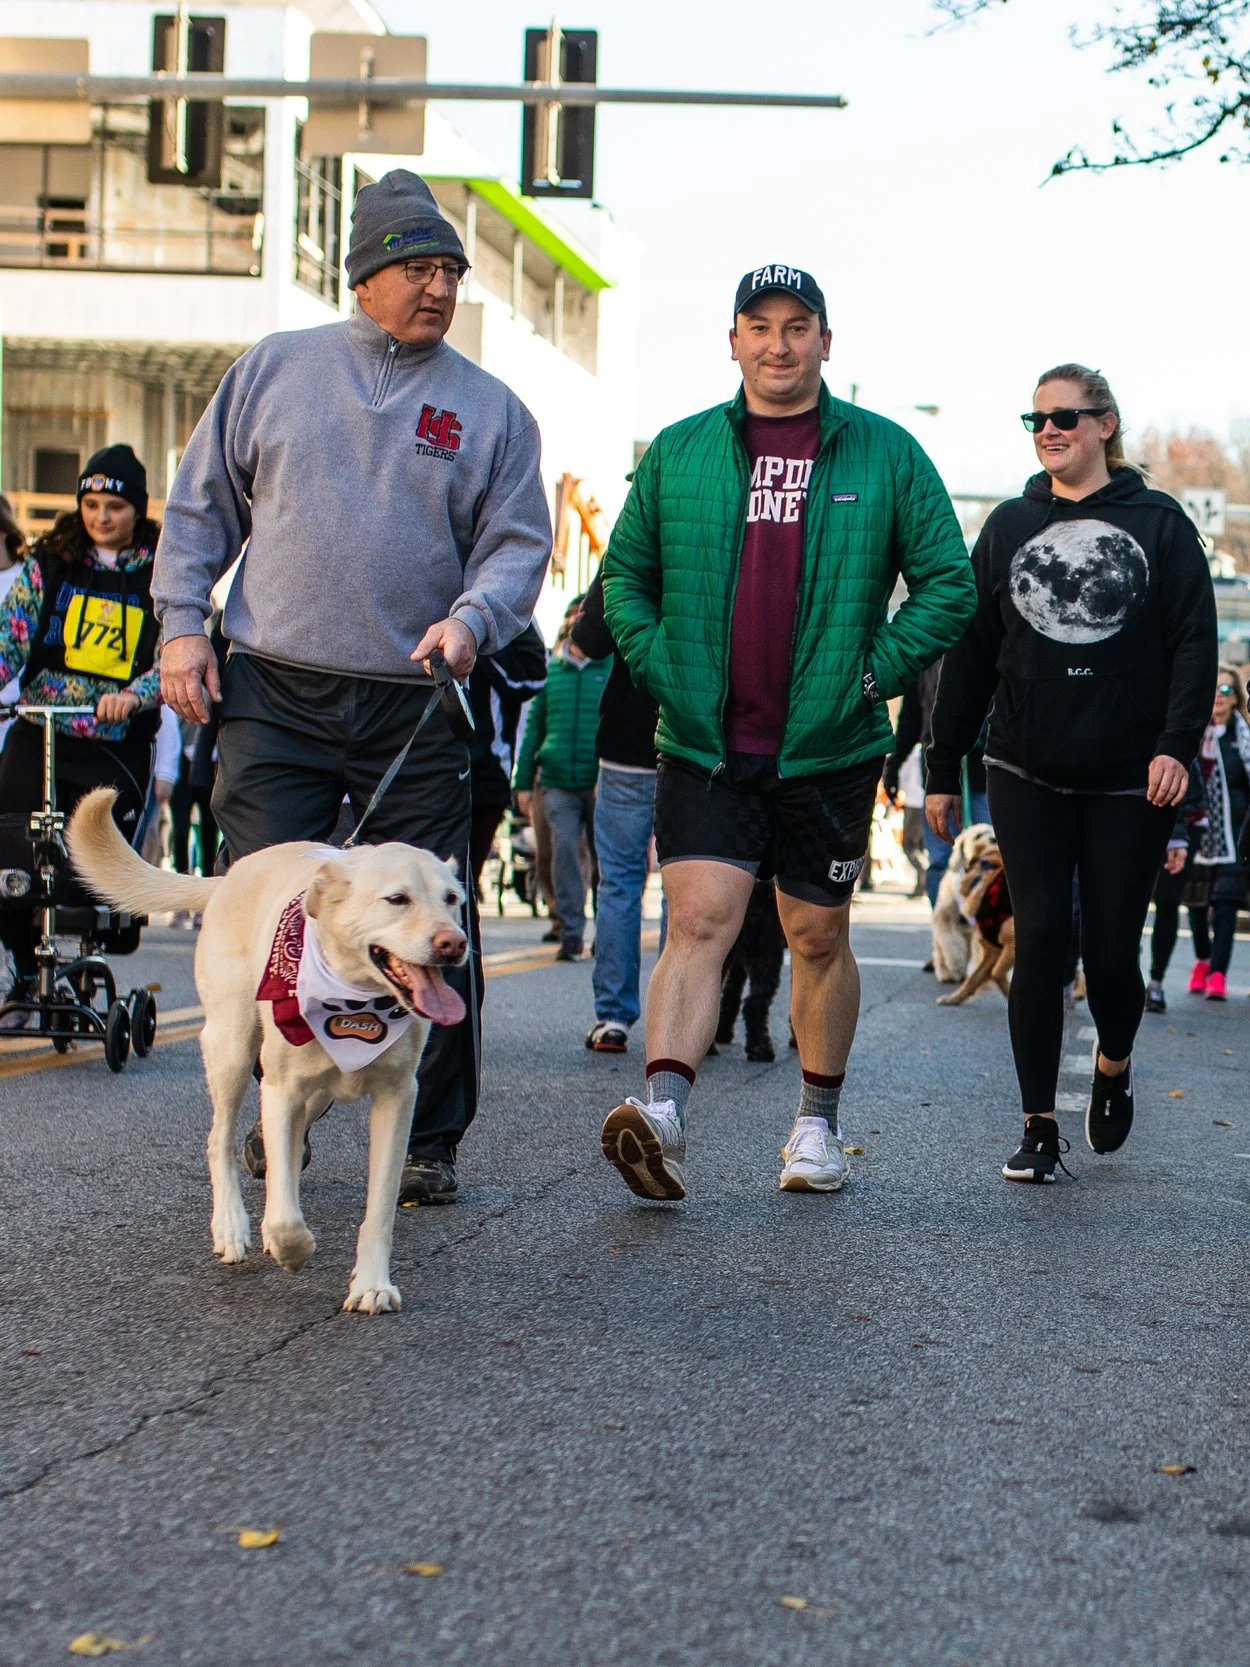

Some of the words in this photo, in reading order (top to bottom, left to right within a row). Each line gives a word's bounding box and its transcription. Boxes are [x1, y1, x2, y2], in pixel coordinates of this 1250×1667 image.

[751, 265, 802, 291] FARM
[415, 443, 457, 462] TIGERS
[746, 488, 807, 523] DNE
[340, 1018, 379, 1033] DASH
